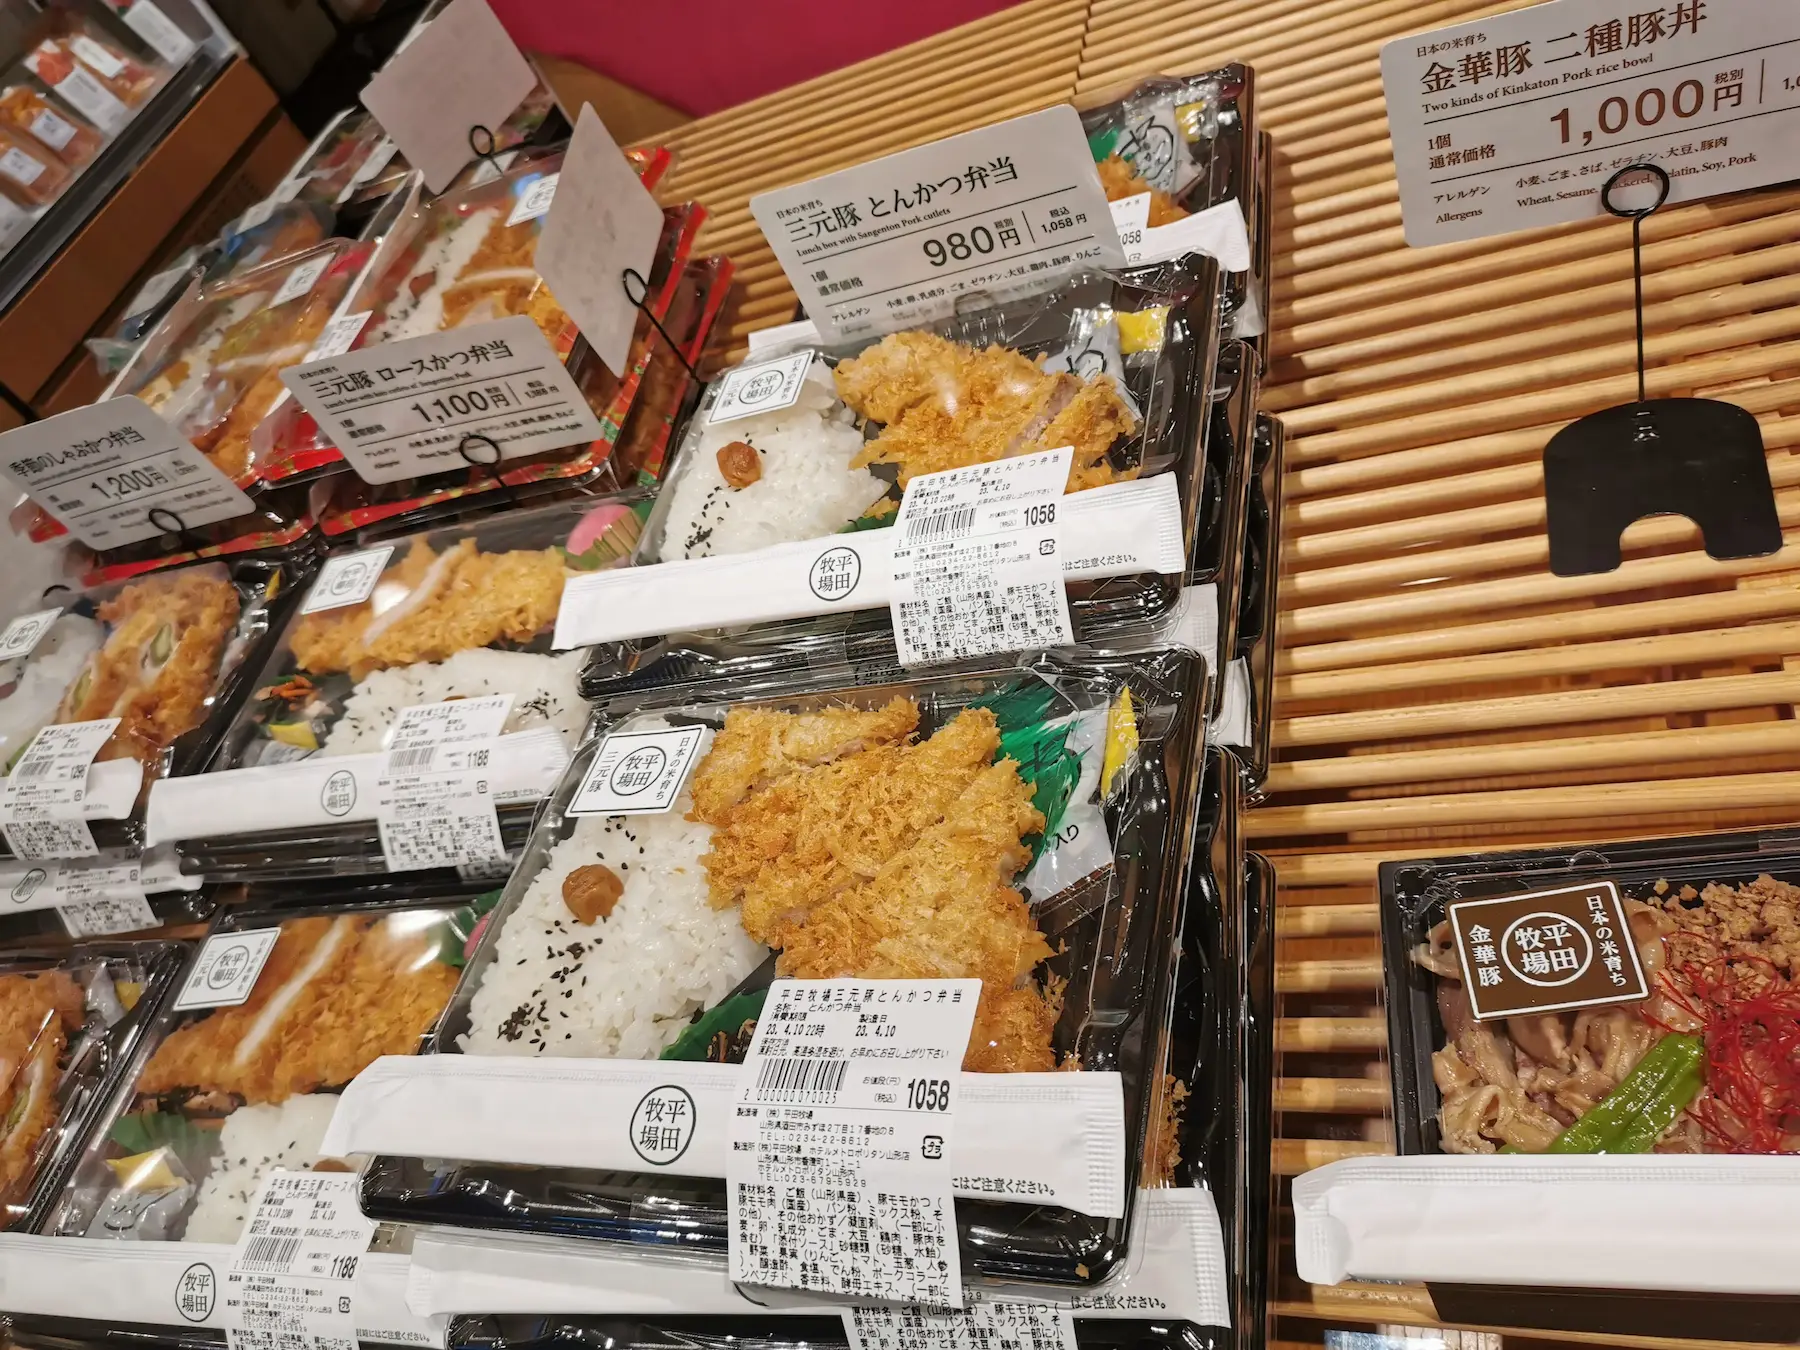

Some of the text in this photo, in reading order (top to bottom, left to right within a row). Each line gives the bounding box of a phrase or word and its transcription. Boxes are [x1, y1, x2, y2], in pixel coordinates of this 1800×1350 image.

[1416, 32, 1488, 58] 日本の米育ち
[1419, 0, 1708, 95] 金華豚 二種豚丼
[1422, 52, 1654, 114] Two kinds of Kinkaton Pork rice bowl
[1714, 68, 1744, 85] 税別
[1550, 79, 1744, 147] 1,000 円
[1428, 133, 1452, 151] 1個
[1428, 144, 1497, 171] 通常価格
[1516, 194, 1554, 208] Wheat,
[1702, 160, 1726, 173] Soy,
[1728, 152, 1758, 167] Pork
[776, 199, 823, 219] 日本の米育ち
[785, 156, 1018, 243] 三元豚 とんかつ弁当
[1433, 186, 1491, 204] アレルゲン
[1040, 213, 1088, 235] 1,058 円
[1048, 206, 1071, 219] 税込
[1435, 207, 1484, 224] Allergens
[796, 207, 951, 257] Lunch box with Sangenton Pork cutlets
[923, 226, 1021, 267] 980 円
[309, 370, 375, 399] 三元豚
[376, 339, 514, 382] ロースかつ弁当
[411, 390, 511, 424] 1,100 円
[91, 469, 153, 501] 1,200
[1023, 503, 1056, 526] 1058
[467, 749, 490, 768] 1188
[587, 751, 619, 793] 三元豚
[655, 736, 691, 800] 日本の米育ち
[1468, 924, 1504, 987] 金華豚
[1586, 895, 1628, 987] 日本の米育ち
[780, 988, 963, 1003] 平田牧場三元豚とんかつ弁当
[859, 1014, 888, 1024] 製造日
[907, 1078, 950, 1112] 1058
[738, 1182, 776, 1197] 原材料名
[330, 1255, 359, 1279] 1188
